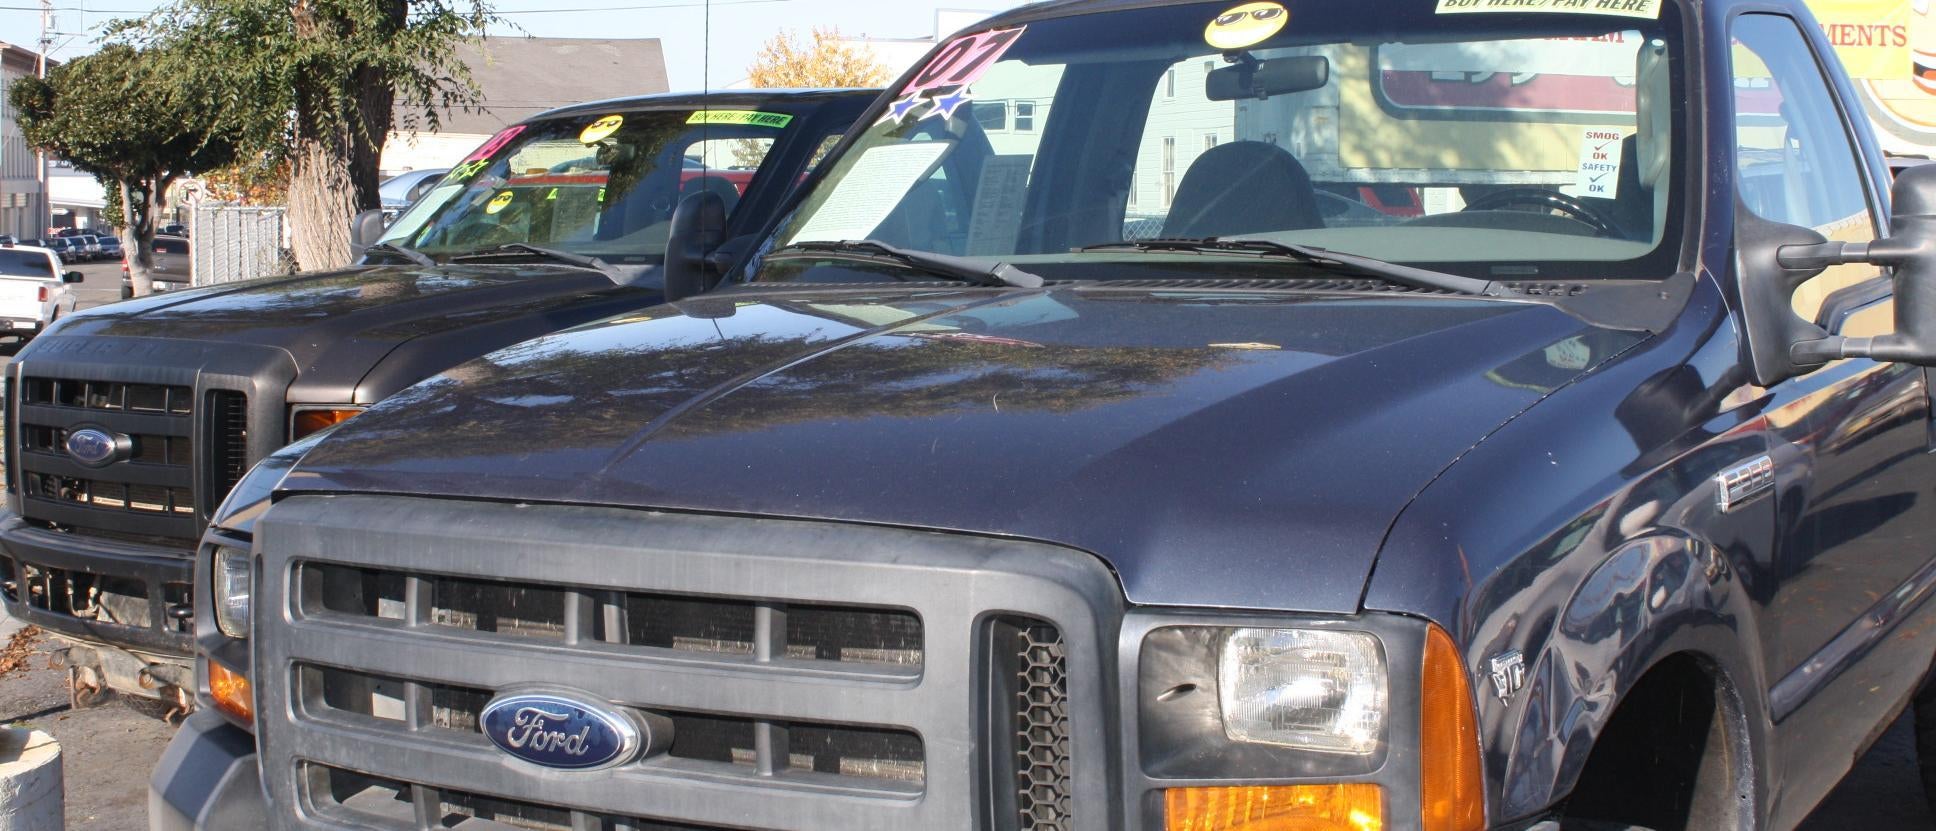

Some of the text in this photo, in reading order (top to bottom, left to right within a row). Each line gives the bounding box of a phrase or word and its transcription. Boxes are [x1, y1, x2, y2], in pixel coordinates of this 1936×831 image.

[1595, 0, 1651, 11] HERE
[914, 30, 1022, 87] 07
[1585, 131, 1620, 141] SMOG
[1592, 152, 1608, 160] OK
[1582, 162, 1617, 172] SAFETY
[1588, 184, 1605, 193] OK
[507, 706, 589, 756] Ford
